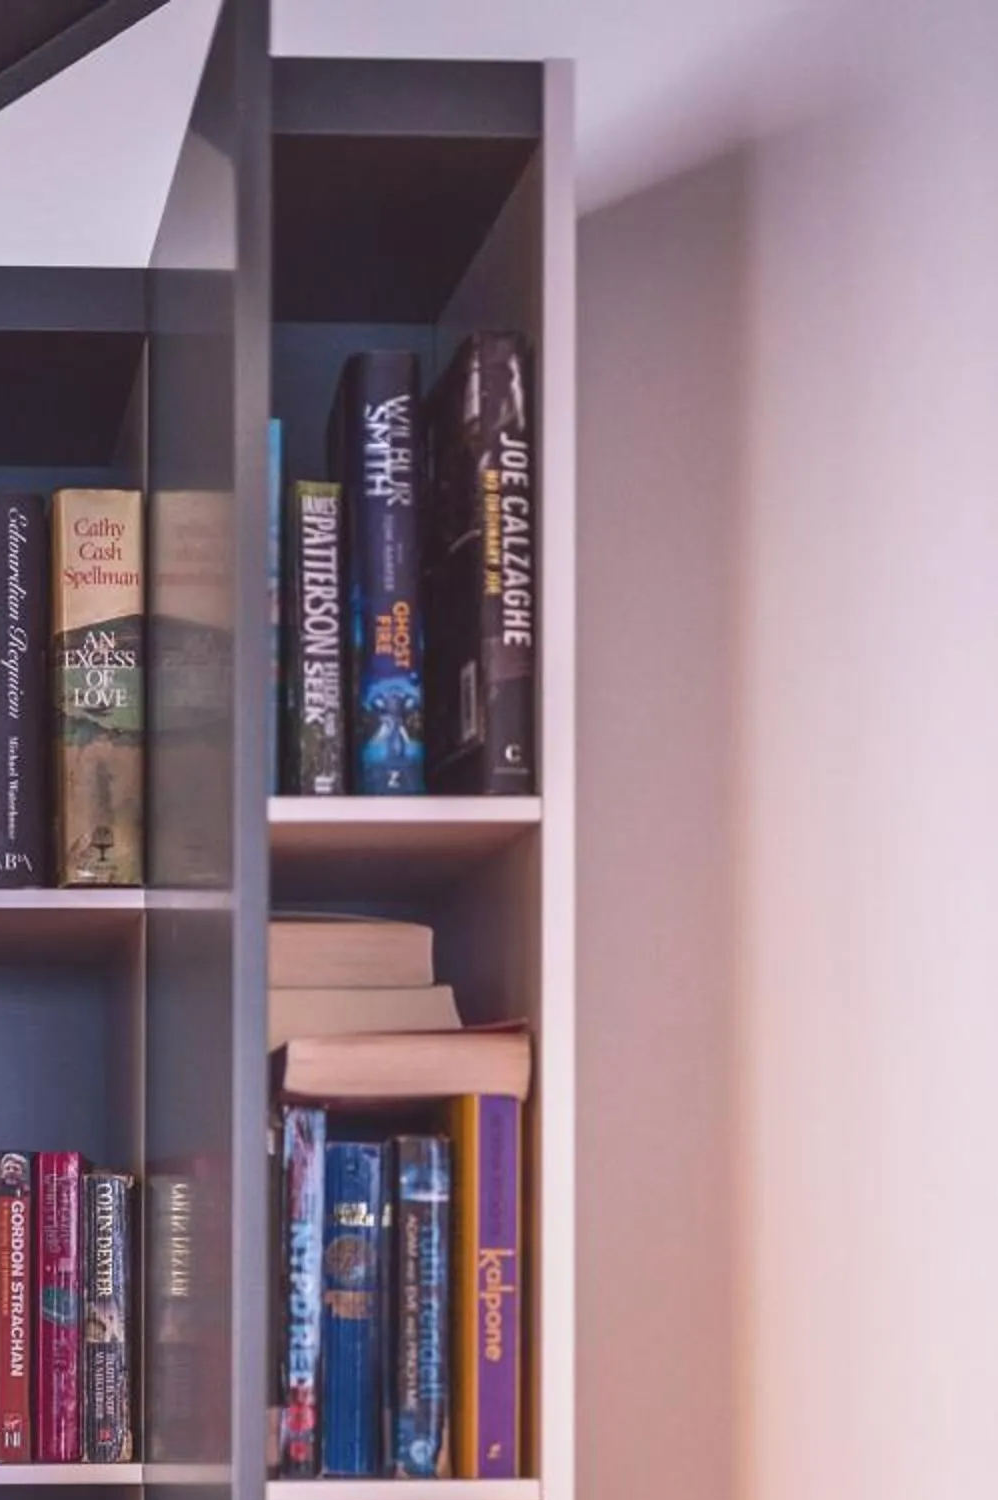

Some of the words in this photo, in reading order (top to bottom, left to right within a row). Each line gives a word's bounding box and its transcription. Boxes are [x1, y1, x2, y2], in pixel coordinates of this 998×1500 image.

[363, 403, 392, 497] SMITH
[386, 394, 411, 506] WILBUR
[500, 432, 528, 486] JOE
[73, 517, 125, 540] Cathy
[79, 542, 122, 561] Cash
[7, 507, 29, 621] Edwardian
[64, 568, 139, 588] Spellman
[302, 513, 339, 655] PATTERSON
[502, 496, 531, 647] CALZAGHE
[63, 649, 136, 668] EXCESS
[85, 632, 115, 648] AN
[375, 614, 393, 656] FIRE
[391, 602, 409, 668] GHOST
[0, 625, 27, 720] Requiem
[73, 688, 128, 707] LOVE
[85, 669, 114, 690] OF
[304, 662, 324, 724] SEEK
[10, 1201, 24, 1277] GORDON
[96, 1182, 112, 1234] COLIN
[96, 1238, 112, 1297] DEXTER
[290, 1221, 316, 1316] NYPD
[419, 1223, 440, 1286] ruth
[10, 1281, 24, 1377] STRACHAN
[479, 1248, 514, 1362] kalpone
[290, 1322, 316, 1388] RED
[419, 1296, 444, 1400] rendell
